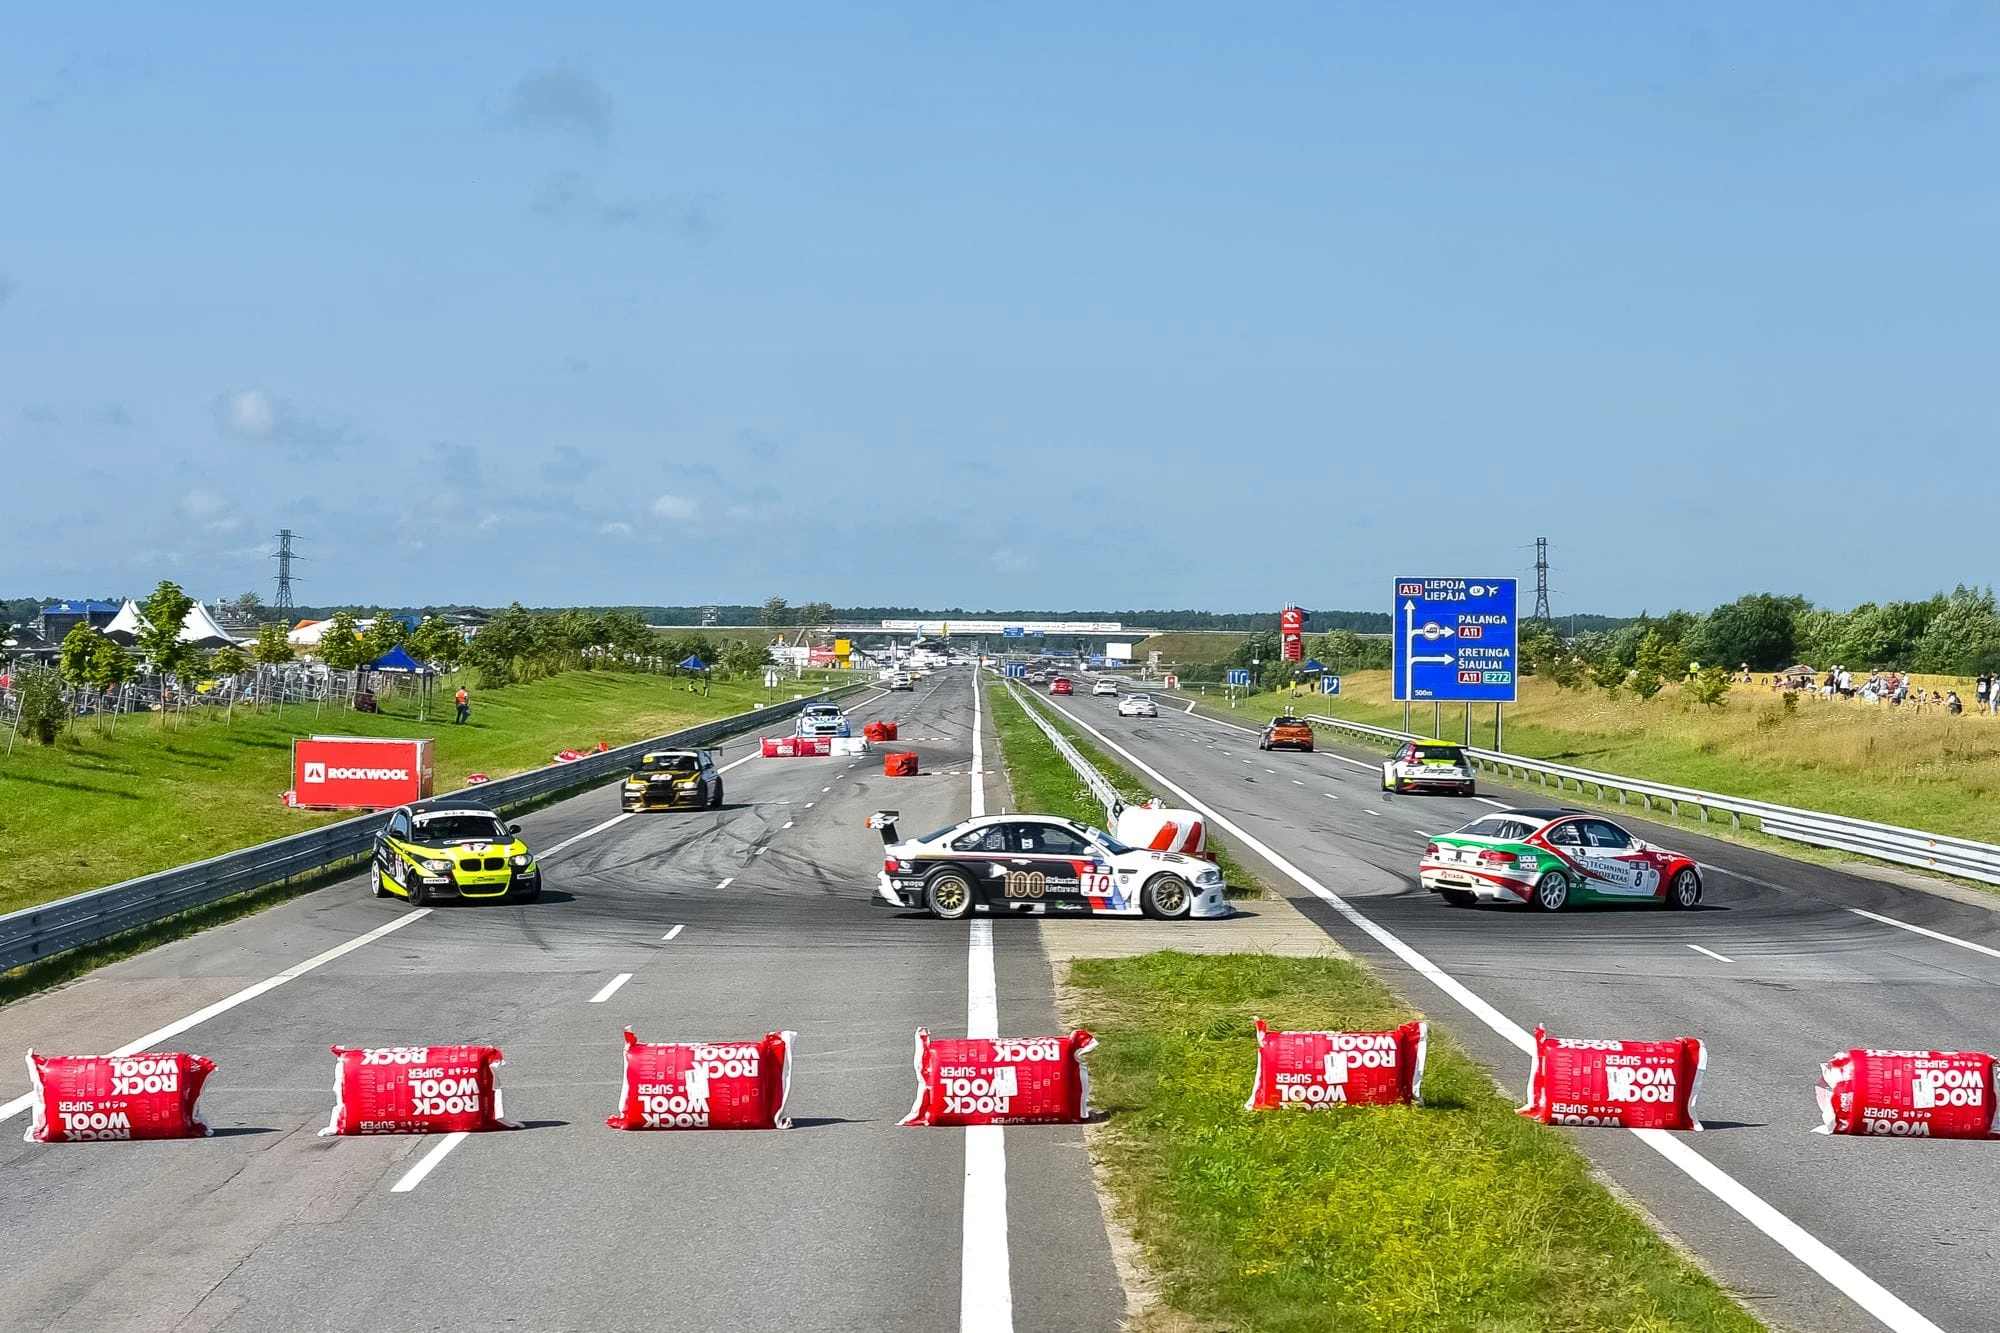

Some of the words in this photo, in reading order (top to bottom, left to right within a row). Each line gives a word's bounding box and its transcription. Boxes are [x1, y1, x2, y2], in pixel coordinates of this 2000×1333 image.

[1402, 584, 1420, 594] A13
[1425, 580, 1466, 589] LIEPOJA
[1425, 592, 1466, 601] LIEPĀJA
[1458, 615, 1508, 624] PALANGA
[1463, 628, 1478, 636] A11
[1458, 648, 1510, 658] KRETINGA
[1458, 659, 1502, 669] ŠIAULIAI
[1463, 673, 1477, 682] A11
[1485, 673, 1510, 682] E272
[328, 768, 409, 780] ROCKWOOL
[414, 820, 429, 828] 17
[1590, 861, 1628, 875] TECHNINIS
[1088, 875, 1110, 892] 10
[1634, 870, 1642, 886] 8
[1004, 871, 1045, 898] 100
[1326, 1036, 1397, 1050] WOOL
[360, 1048, 428, 1065] ROCK
[689, 1046, 760, 1060] WOOL
[993, 1044, 1060, 1062] ROCK
[1330, 1050, 1396, 1068] ROC
[1605, 1055, 1642, 1065] SUPER
[1914, 1060, 1950, 1068] SUPER
[109, 1058, 178, 1077] WOOL
[408, 1068, 444, 1078] SUPER
[940, 1066, 976, 1076] SUPER
[1276, 1073, 1312, 1083] SUPER
[110, 1074, 178, 1096] ROCK
[408, 1078, 480, 1097] WOOL
[638, 1084, 674, 1094] SUPER
[1276, 1084, 1347, 1102] WOOL
[1608, 1085, 1674, 1102] ROC
[1934, 1088, 1982, 1106] ROC
[58, 1101, 94, 1112] SUPER
[412, 1096, 480, 1116] ROCK
[638, 1096, 710, 1112] WOOL
[943, 1096, 1010, 1114] ROCK
[1552, 1102, 1588, 1112] SUPER
[1864, 1108, 1898, 1118] SUPER
[58, 1112, 131, 1130] WOOL
[360, 1120, 396, 1128] SUPER
[642, 1112, 708, 1128] ROCK
[1552, 1114, 1620, 1126] WOOL
[1862, 1118, 1930, 1136] WOOL
[64, 1129, 131, 1141] ROCK
